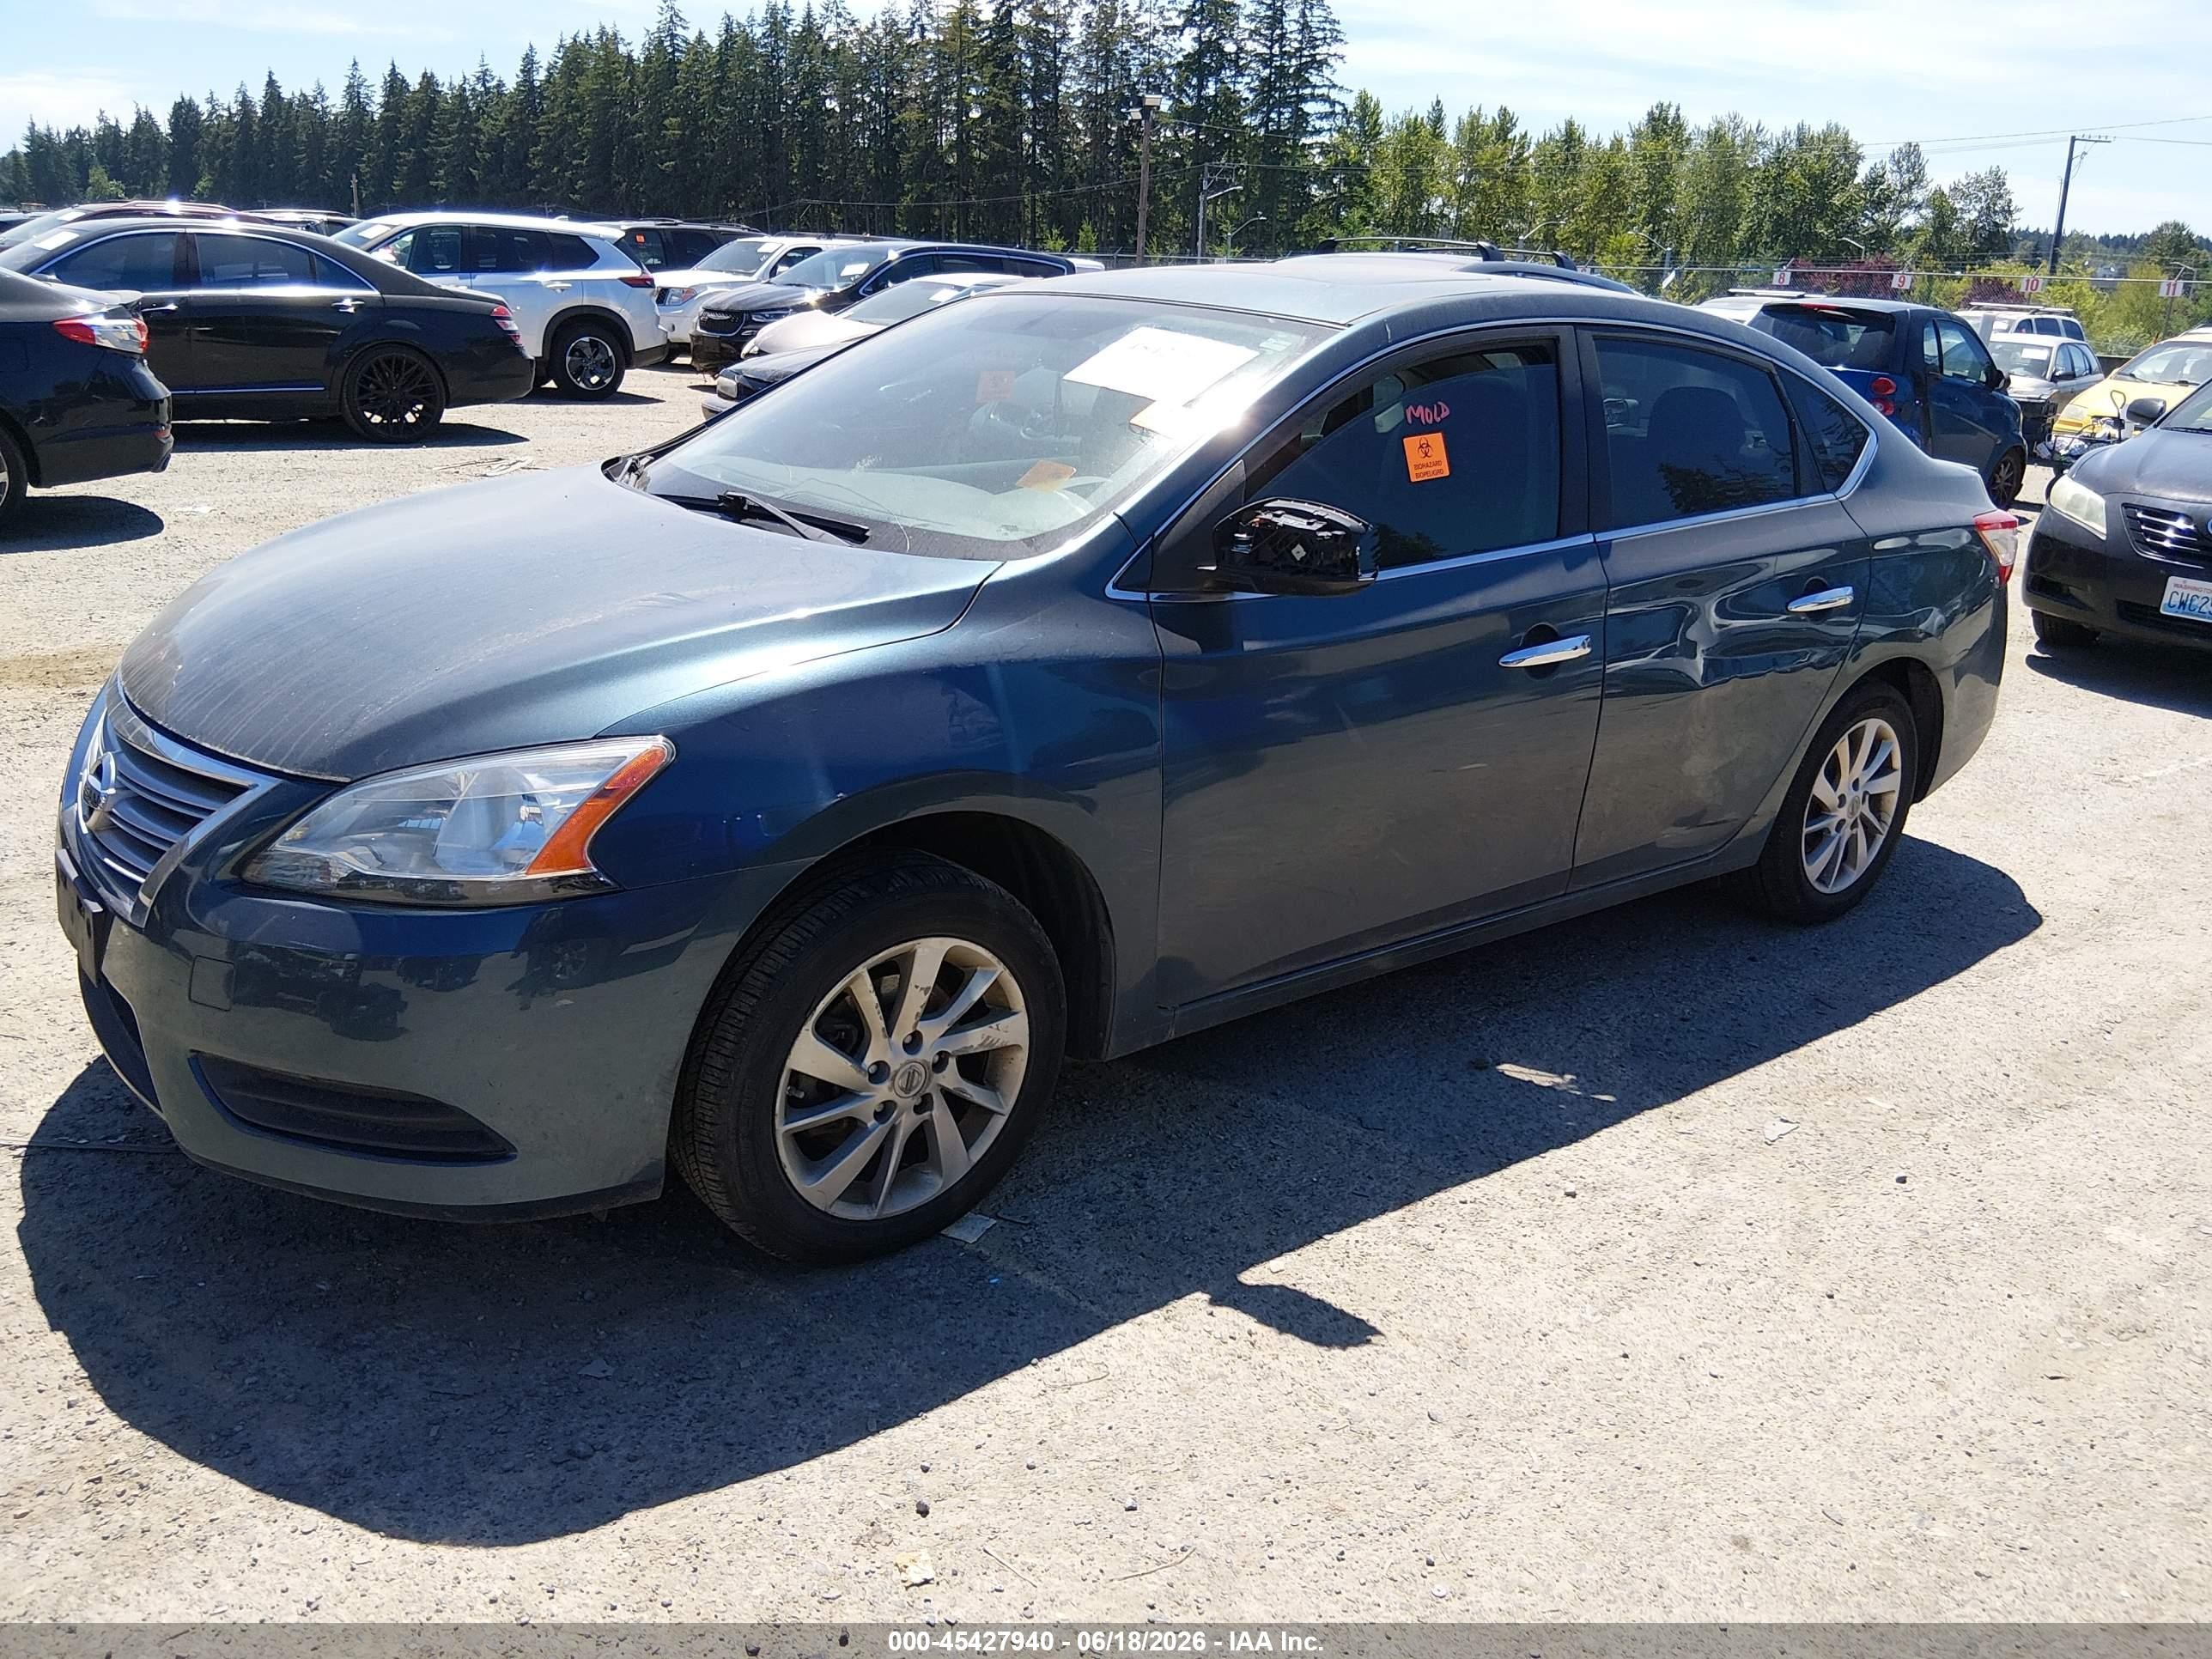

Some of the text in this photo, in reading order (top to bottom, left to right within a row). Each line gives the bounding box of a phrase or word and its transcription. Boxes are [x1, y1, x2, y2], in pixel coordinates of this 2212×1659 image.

[1778, 273, 1785, 284] 8
[1898, 275, 1906, 288] 9
[2024, 278, 2040, 292] 10
[2165, 283, 2178, 296] 11
[1406, 401, 1449, 425] MOLD
[1413, 460, 1443, 471] BIOHAZARD
